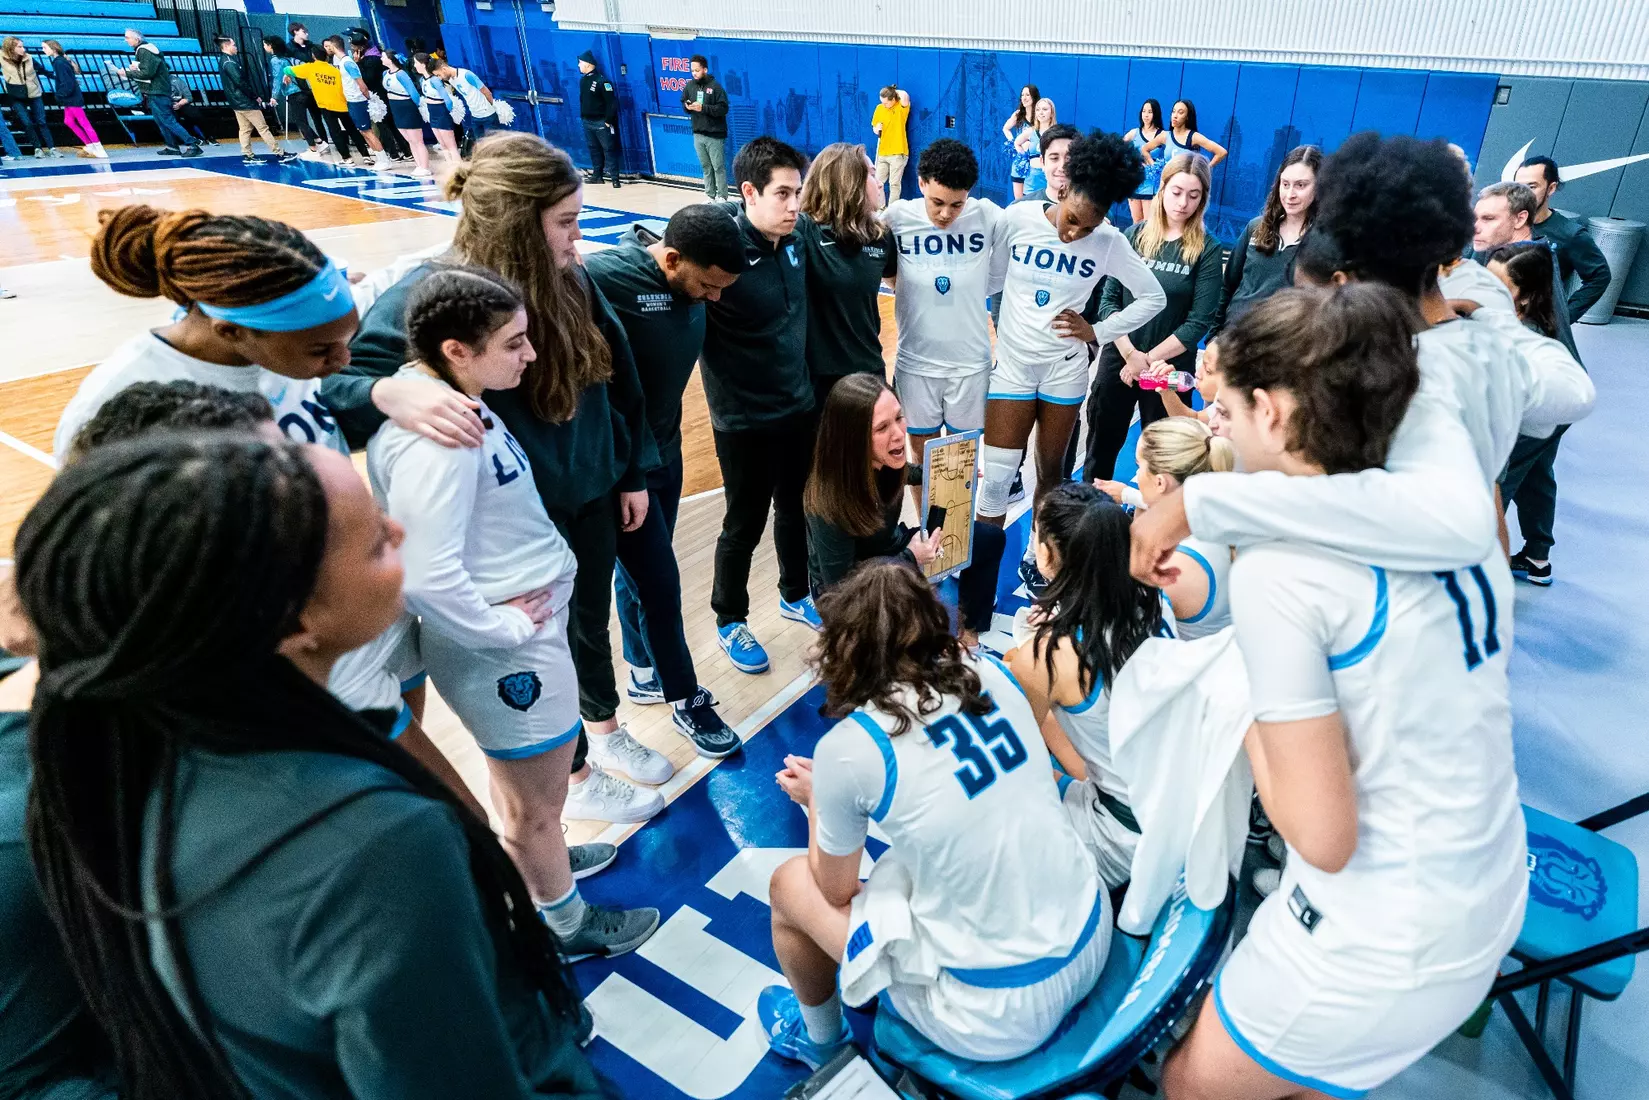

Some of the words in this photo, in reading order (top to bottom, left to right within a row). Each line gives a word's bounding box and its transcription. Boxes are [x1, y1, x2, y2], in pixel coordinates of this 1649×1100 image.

[661, 57, 690, 73] FIRE
[315, 73, 336, 81] EVENT
[317, 77, 336, 86] STAFF
[660, 76, 692, 92] HOS
[897, 233, 985, 255] LIONS
[1012, 244, 1096, 278] LIONS
[1141, 257, 1190, 275] UMBIA
[1432, 564, 1501, 672] 11
[923, 690, 1028, 800] 35
